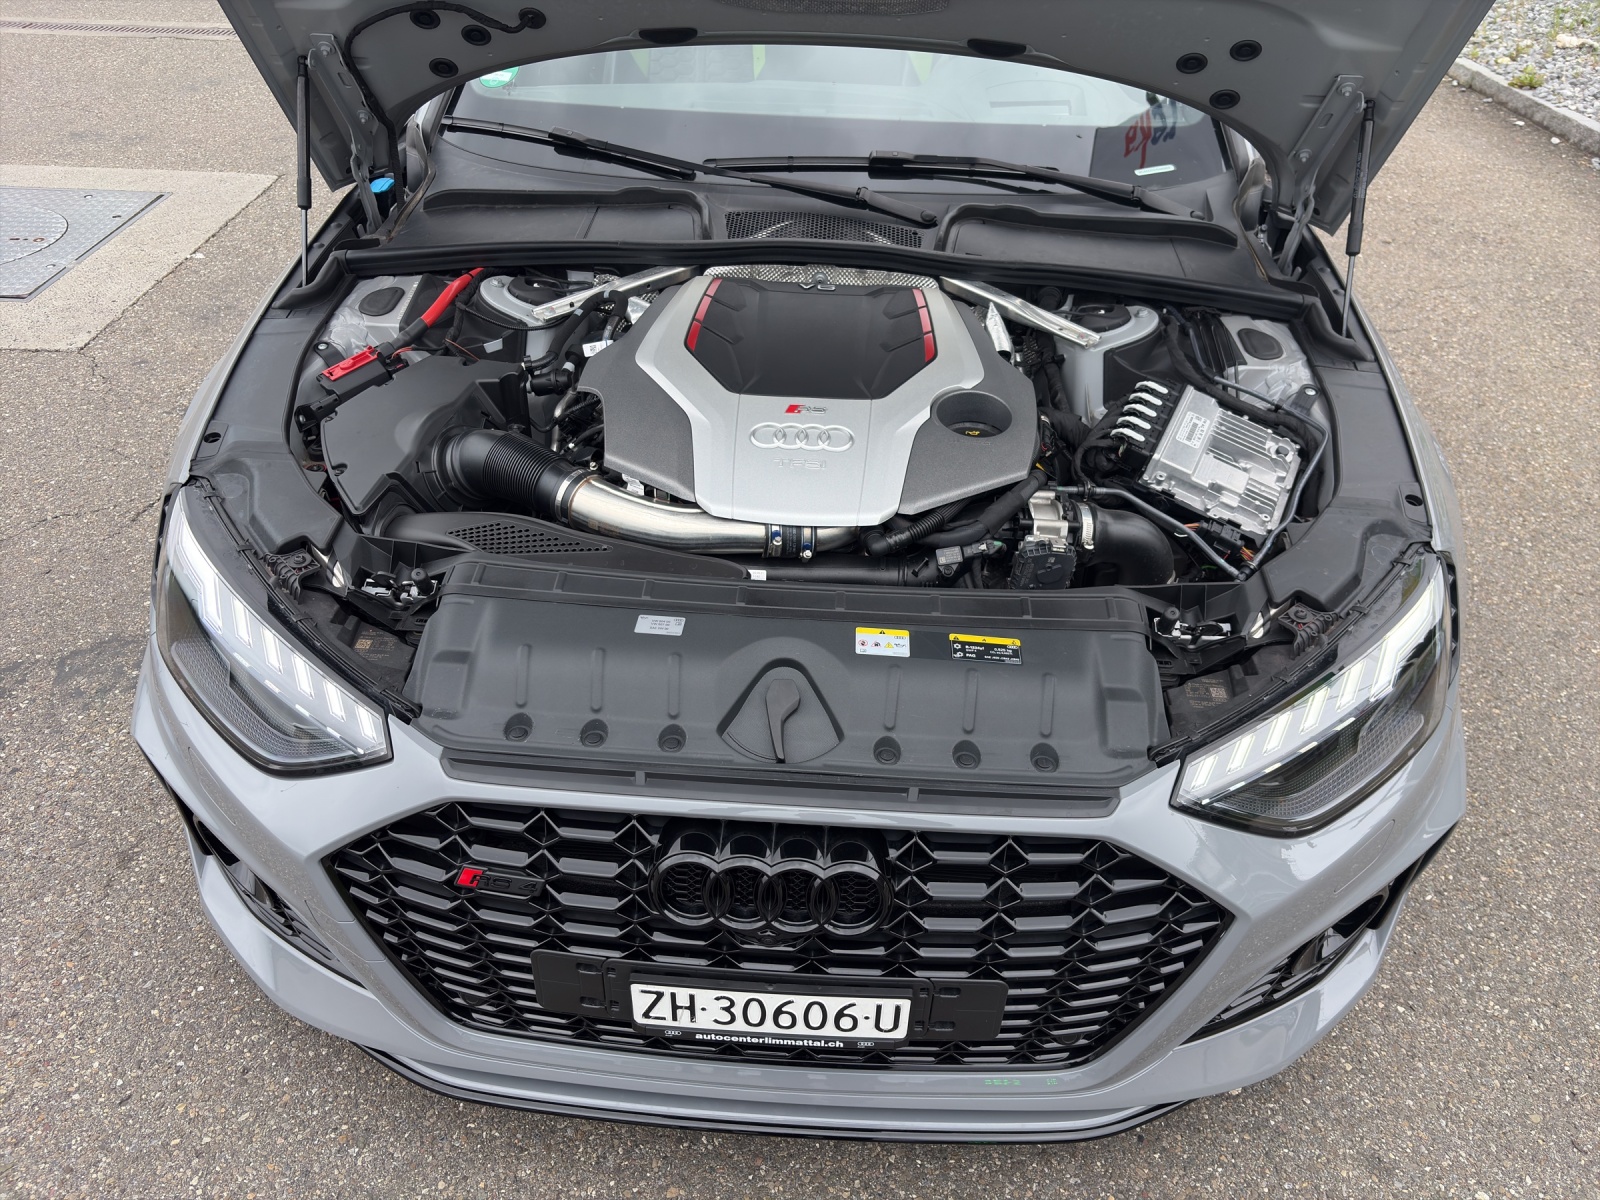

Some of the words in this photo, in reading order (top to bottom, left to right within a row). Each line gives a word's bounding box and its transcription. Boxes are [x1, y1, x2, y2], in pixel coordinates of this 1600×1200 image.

[786, 404, 828, 415] RS
[773, 458, 826, 470] TFSI
[460, 868, 513, 889] RS
[695, 1033, 844, 1048] autocenterlimmattal.ch
